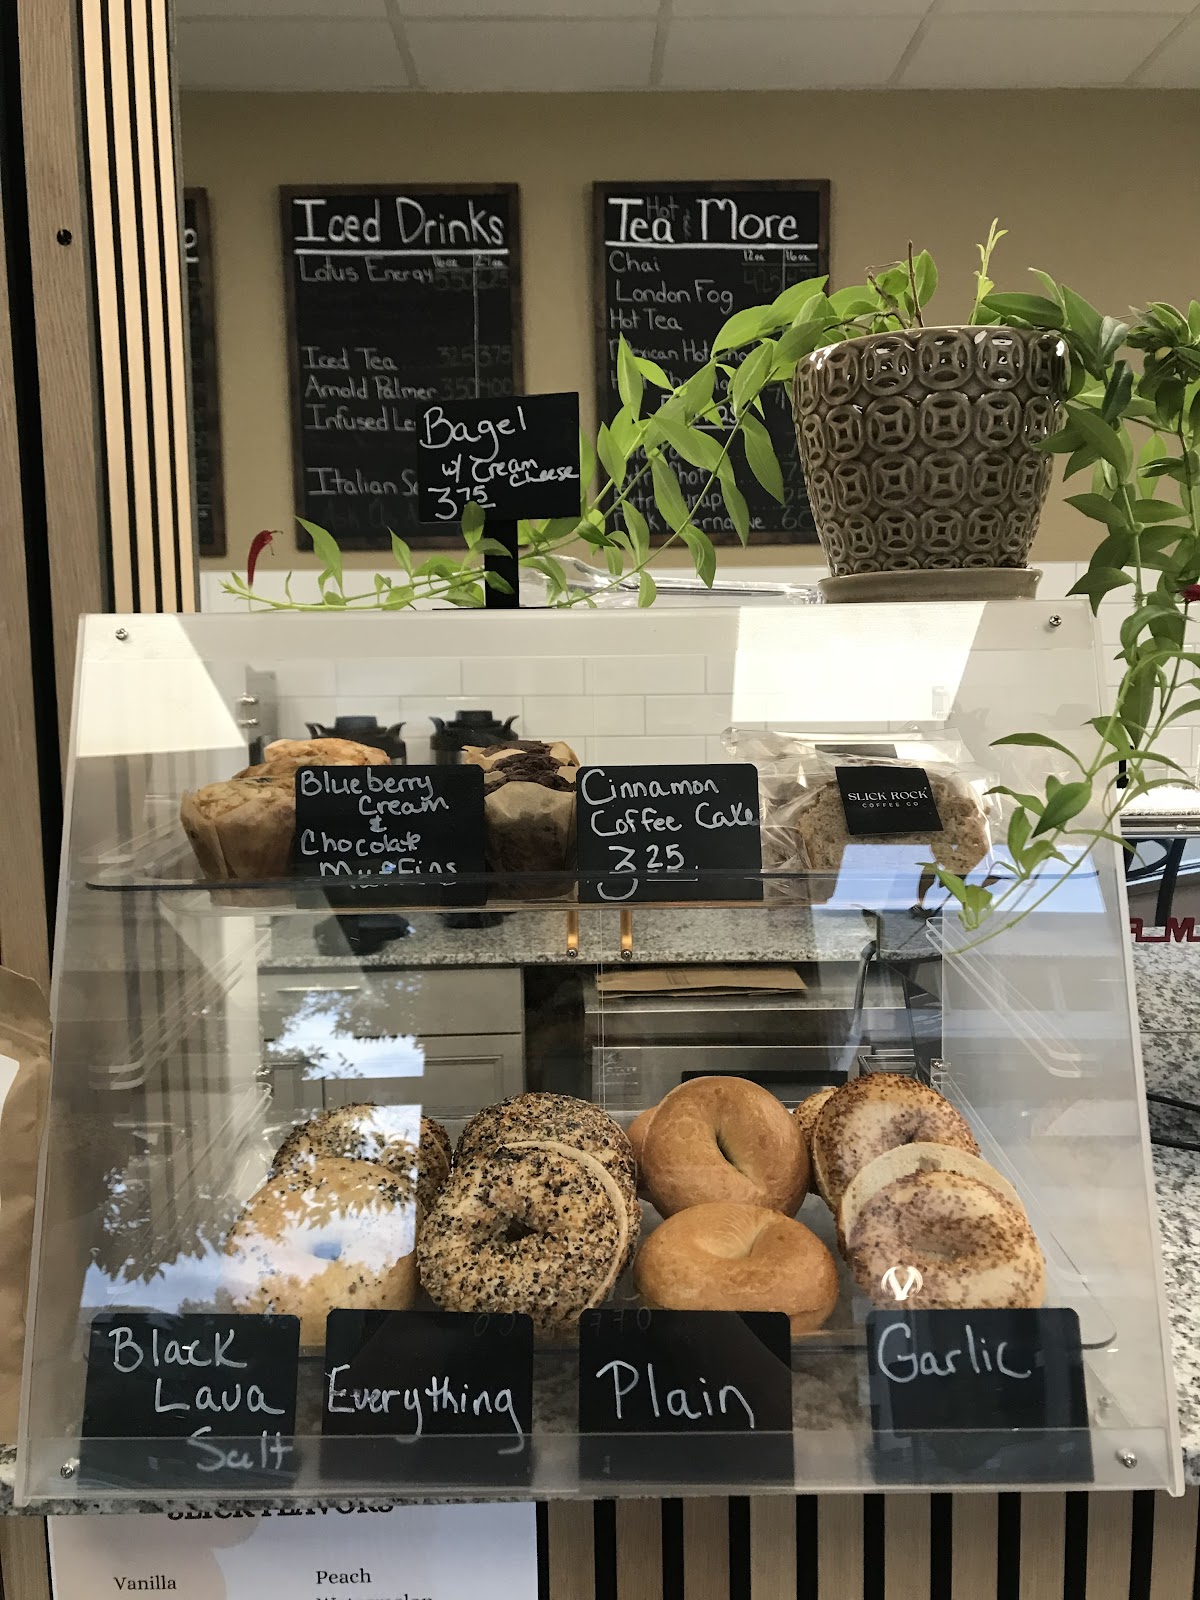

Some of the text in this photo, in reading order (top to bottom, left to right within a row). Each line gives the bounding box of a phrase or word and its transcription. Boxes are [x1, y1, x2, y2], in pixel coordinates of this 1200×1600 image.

[293, 197, 505, 245] Iced Drinks
[608, 197, 675, 243] Tea
[696, 198, 800, 241] More
[300, 253, 436, 283] Lotus Energy
[608, 251, 662, 273] Chai
[615, 279, 734, 315] London Fog
[609, 308, 683, 331] Hot Tea
[302, 346, 399, 371] Iced Tea
[304, 375, 438, 400] Arnold Palmer
[304, 403, 389, 431] Infused
[419, 406, 526, 462] Bagel
[305, 466, 399, 495] Italian
[469, 457, 539, 483] Cream
[509, 465, 579, 488] Cheese
[301, 767, 433, 799] Blueberry
[581, 768, 720, 806] Cinnamon
[847, 787, 928, 801] SLICK ROCK
[358, 795, 450, 816] Cream
[590, 802, 759, 837] Coffee Cake
[861, 801, 900, 809] COFFEE
[108, 1326, 248, 1373] Black
[876, 1322, 1034, 1384] Garlic
[154, 1377, 286, 1415] Lava
[325, 1364, 524, 1455] Everything
[595, 1360, 756, 1429] Plain
[113, 1576, 177, 1591] Vanilla
[316, 1568, 372, 1585] Peach
